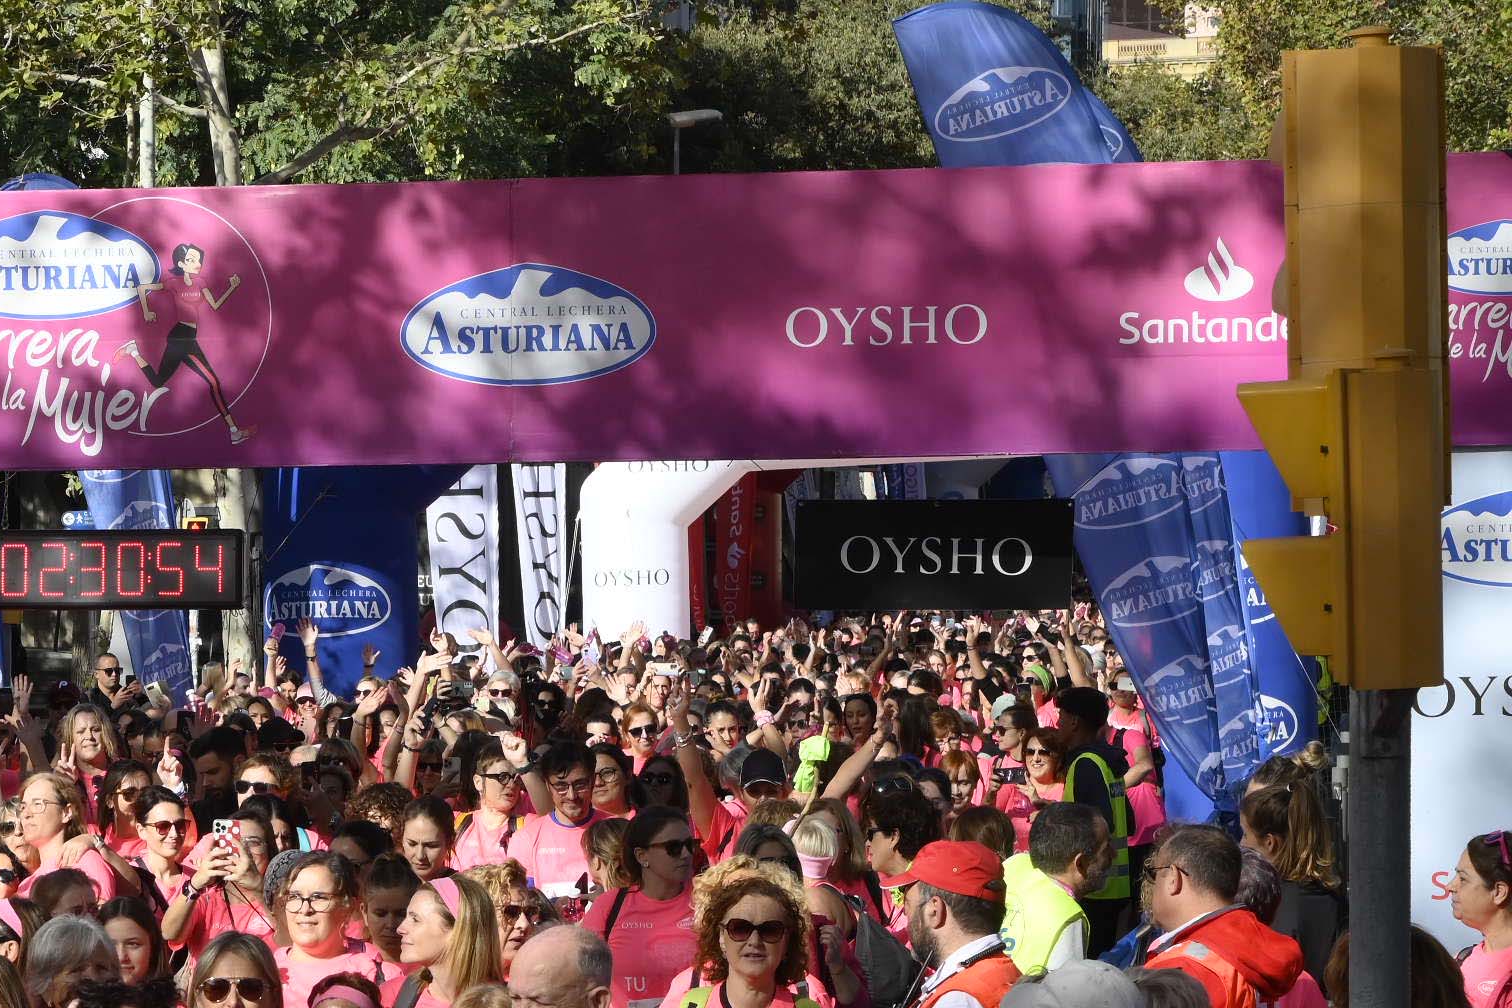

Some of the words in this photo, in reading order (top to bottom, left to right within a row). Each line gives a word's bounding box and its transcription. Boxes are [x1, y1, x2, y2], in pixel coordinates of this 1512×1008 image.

[459, 304, 540, 321] CENTRAL
[546, 303, 629, 317] LECHERA
[785, 304, 989, 348] OYSHO
[420, 310, 637, 356] ASTURIANA
[1469, 330, 1487, 359] la
[1, 370, 26, 411] la
[20, 362, 170, 457] Mujer
[1, 541, 223, 597] 02:30:54
[840, 535, 1033, 576] OYSHO
[594, 568, 670, 588] OYSHO
[271, 594, 382, 619] ASTURIANA
[624, 976, 646, 992] TU
